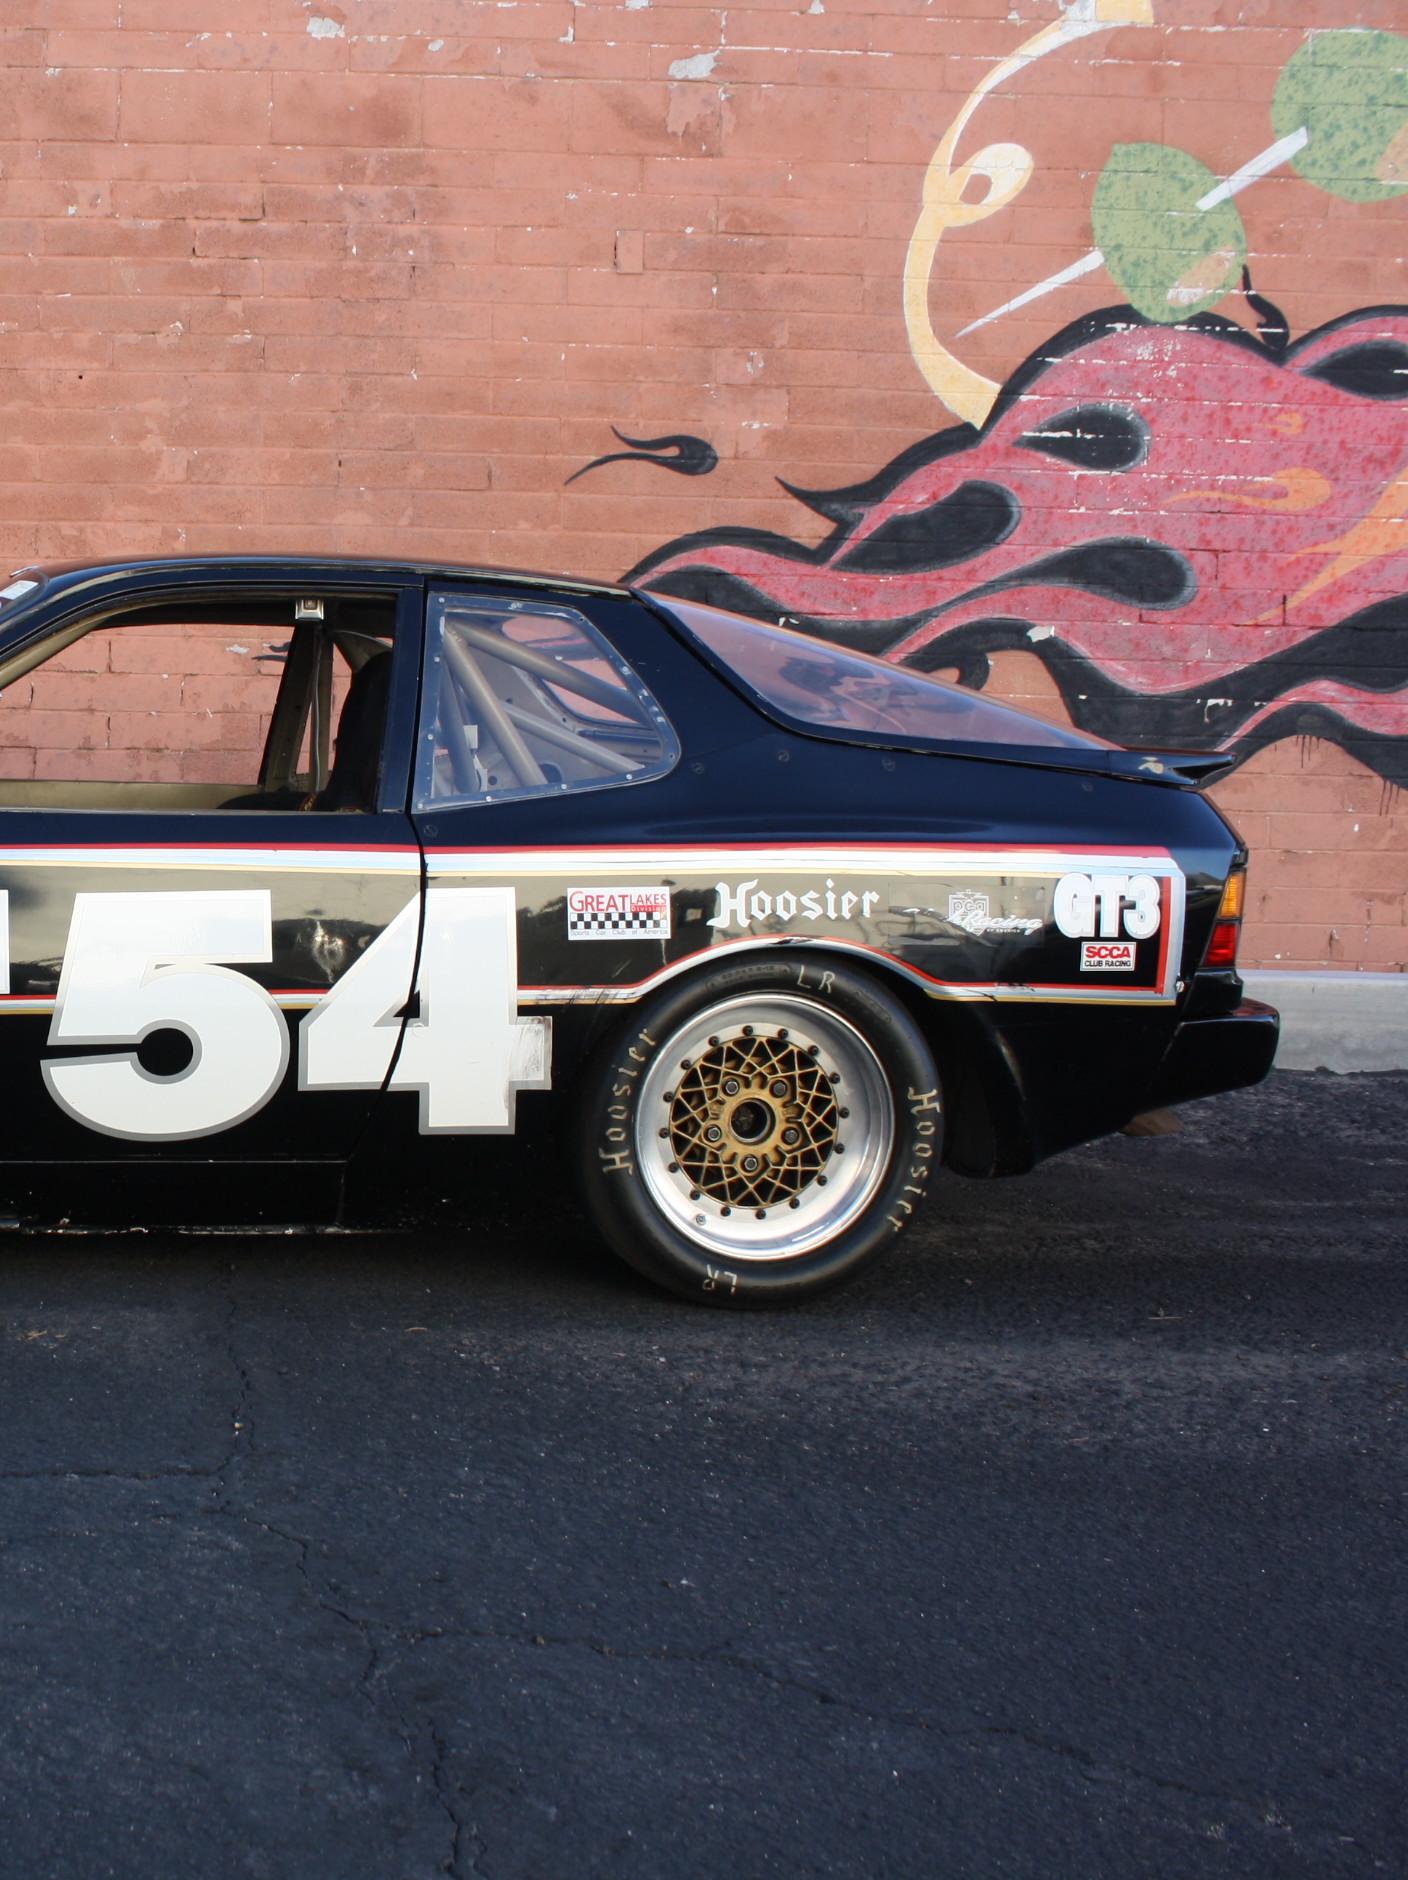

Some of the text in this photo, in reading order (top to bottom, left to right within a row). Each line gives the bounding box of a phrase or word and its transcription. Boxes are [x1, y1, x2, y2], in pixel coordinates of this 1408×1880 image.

[569, 891, 667, 912] GREAT LAKES
[706, 878, 880, 928] Hoosier
[1053, 872, 1161, 940] GT3
[1085, 946, 1132, 959] SCCA
[39, 886, 553, 1142] 54
